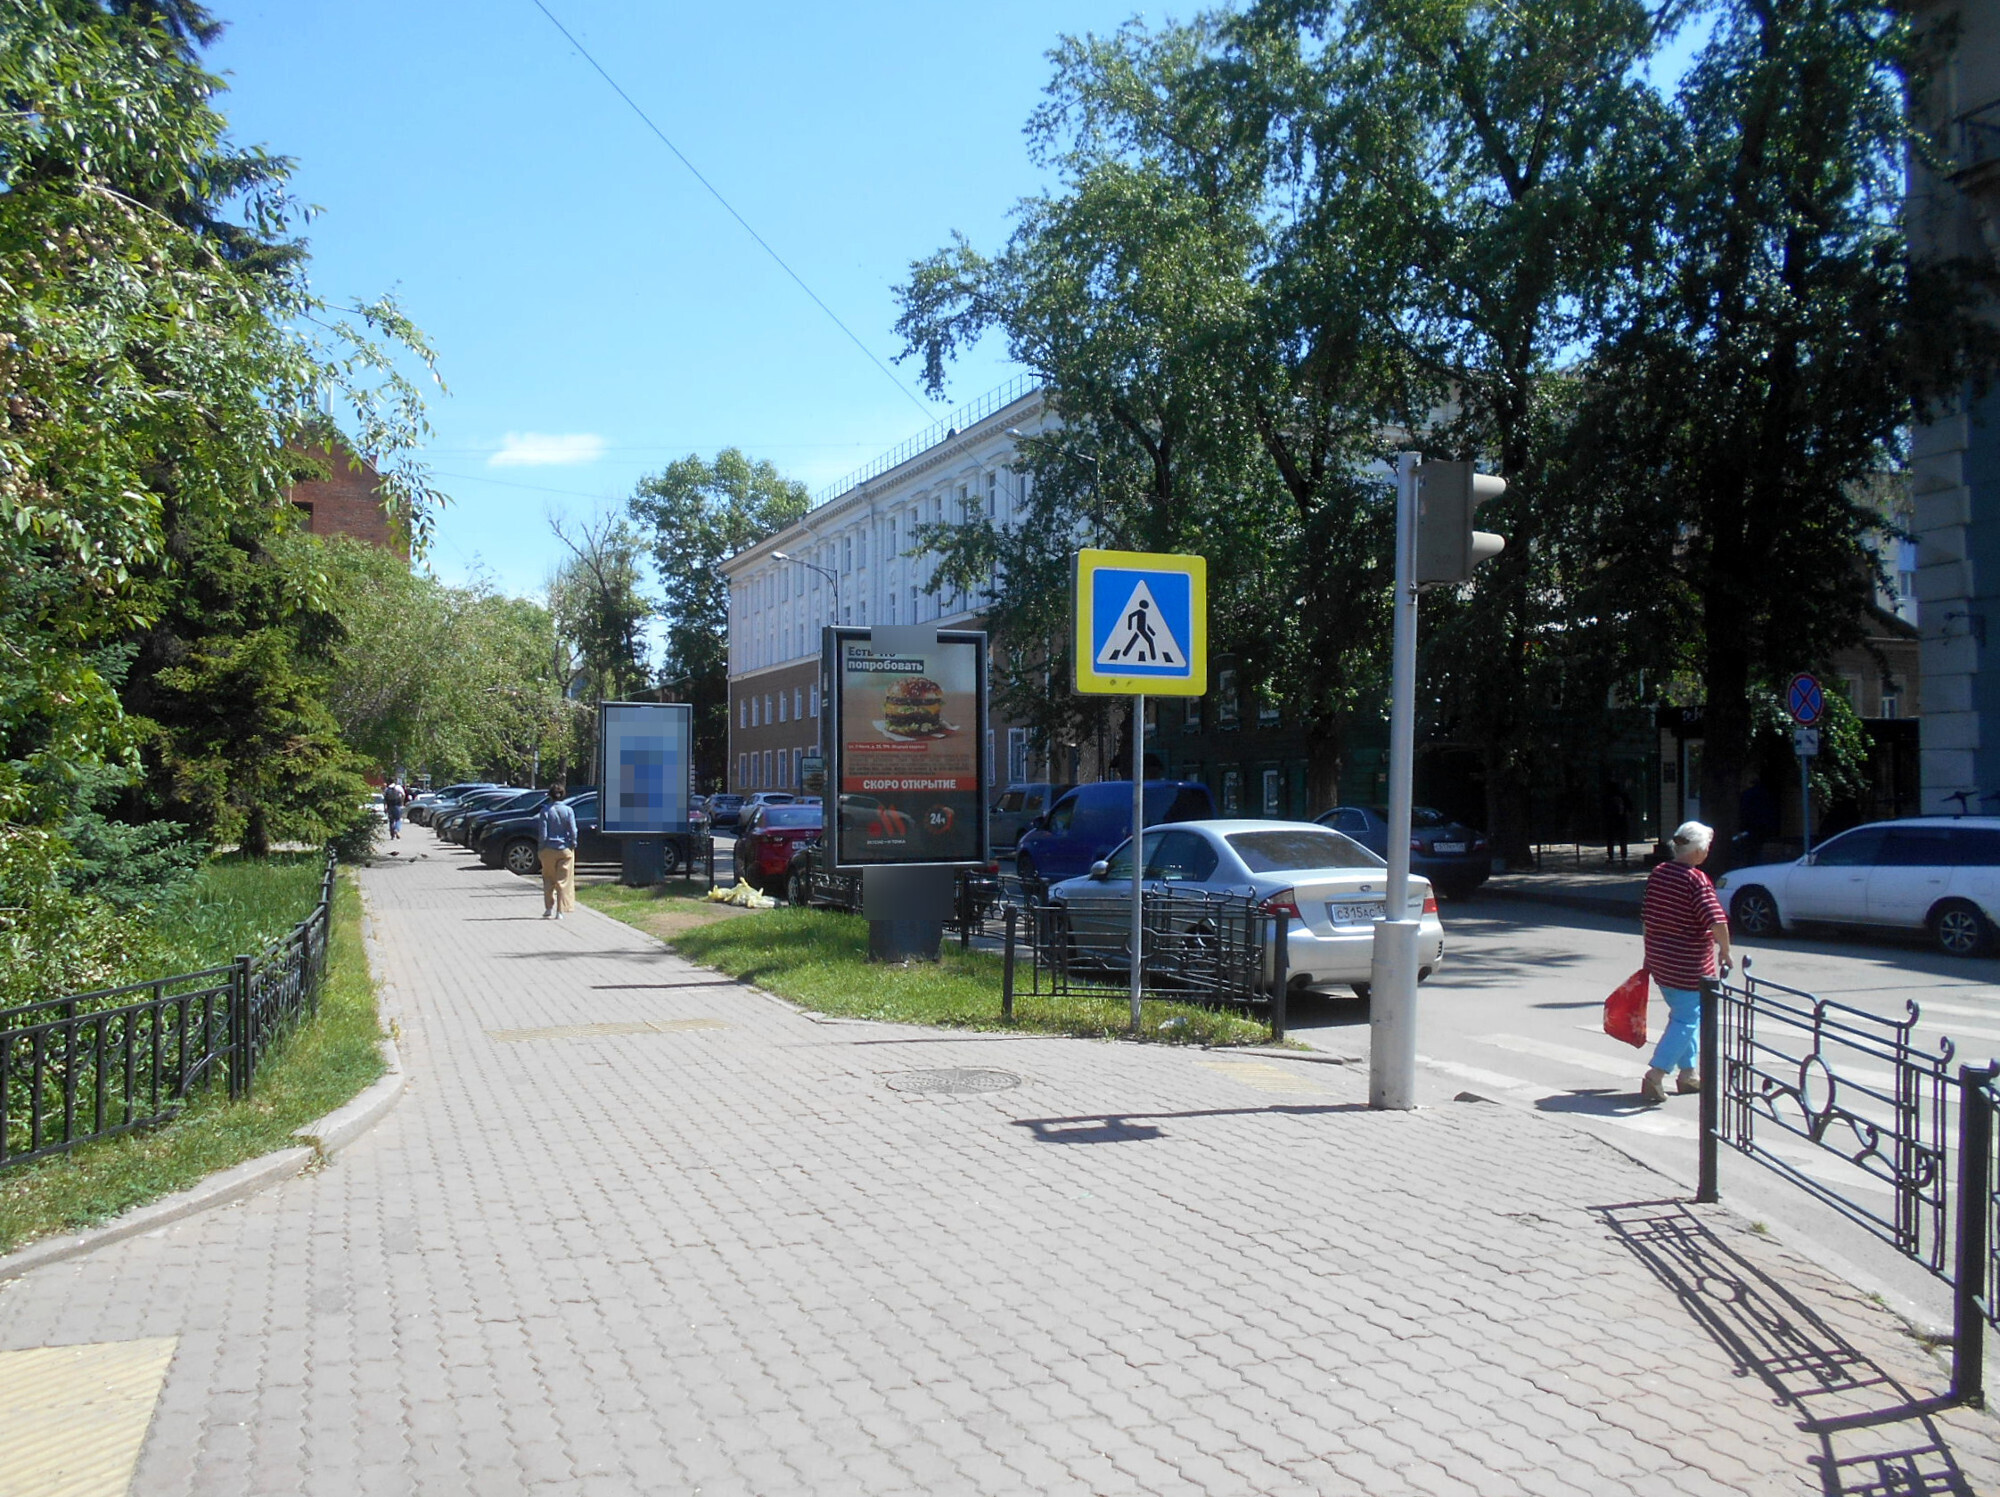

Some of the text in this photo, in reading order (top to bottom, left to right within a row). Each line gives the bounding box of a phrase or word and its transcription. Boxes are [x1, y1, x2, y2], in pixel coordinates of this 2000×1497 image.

[848, 659, 923, 671] попробовать
[863, 779, 956, 789] СКОРО ОТКРЫТИЕ
